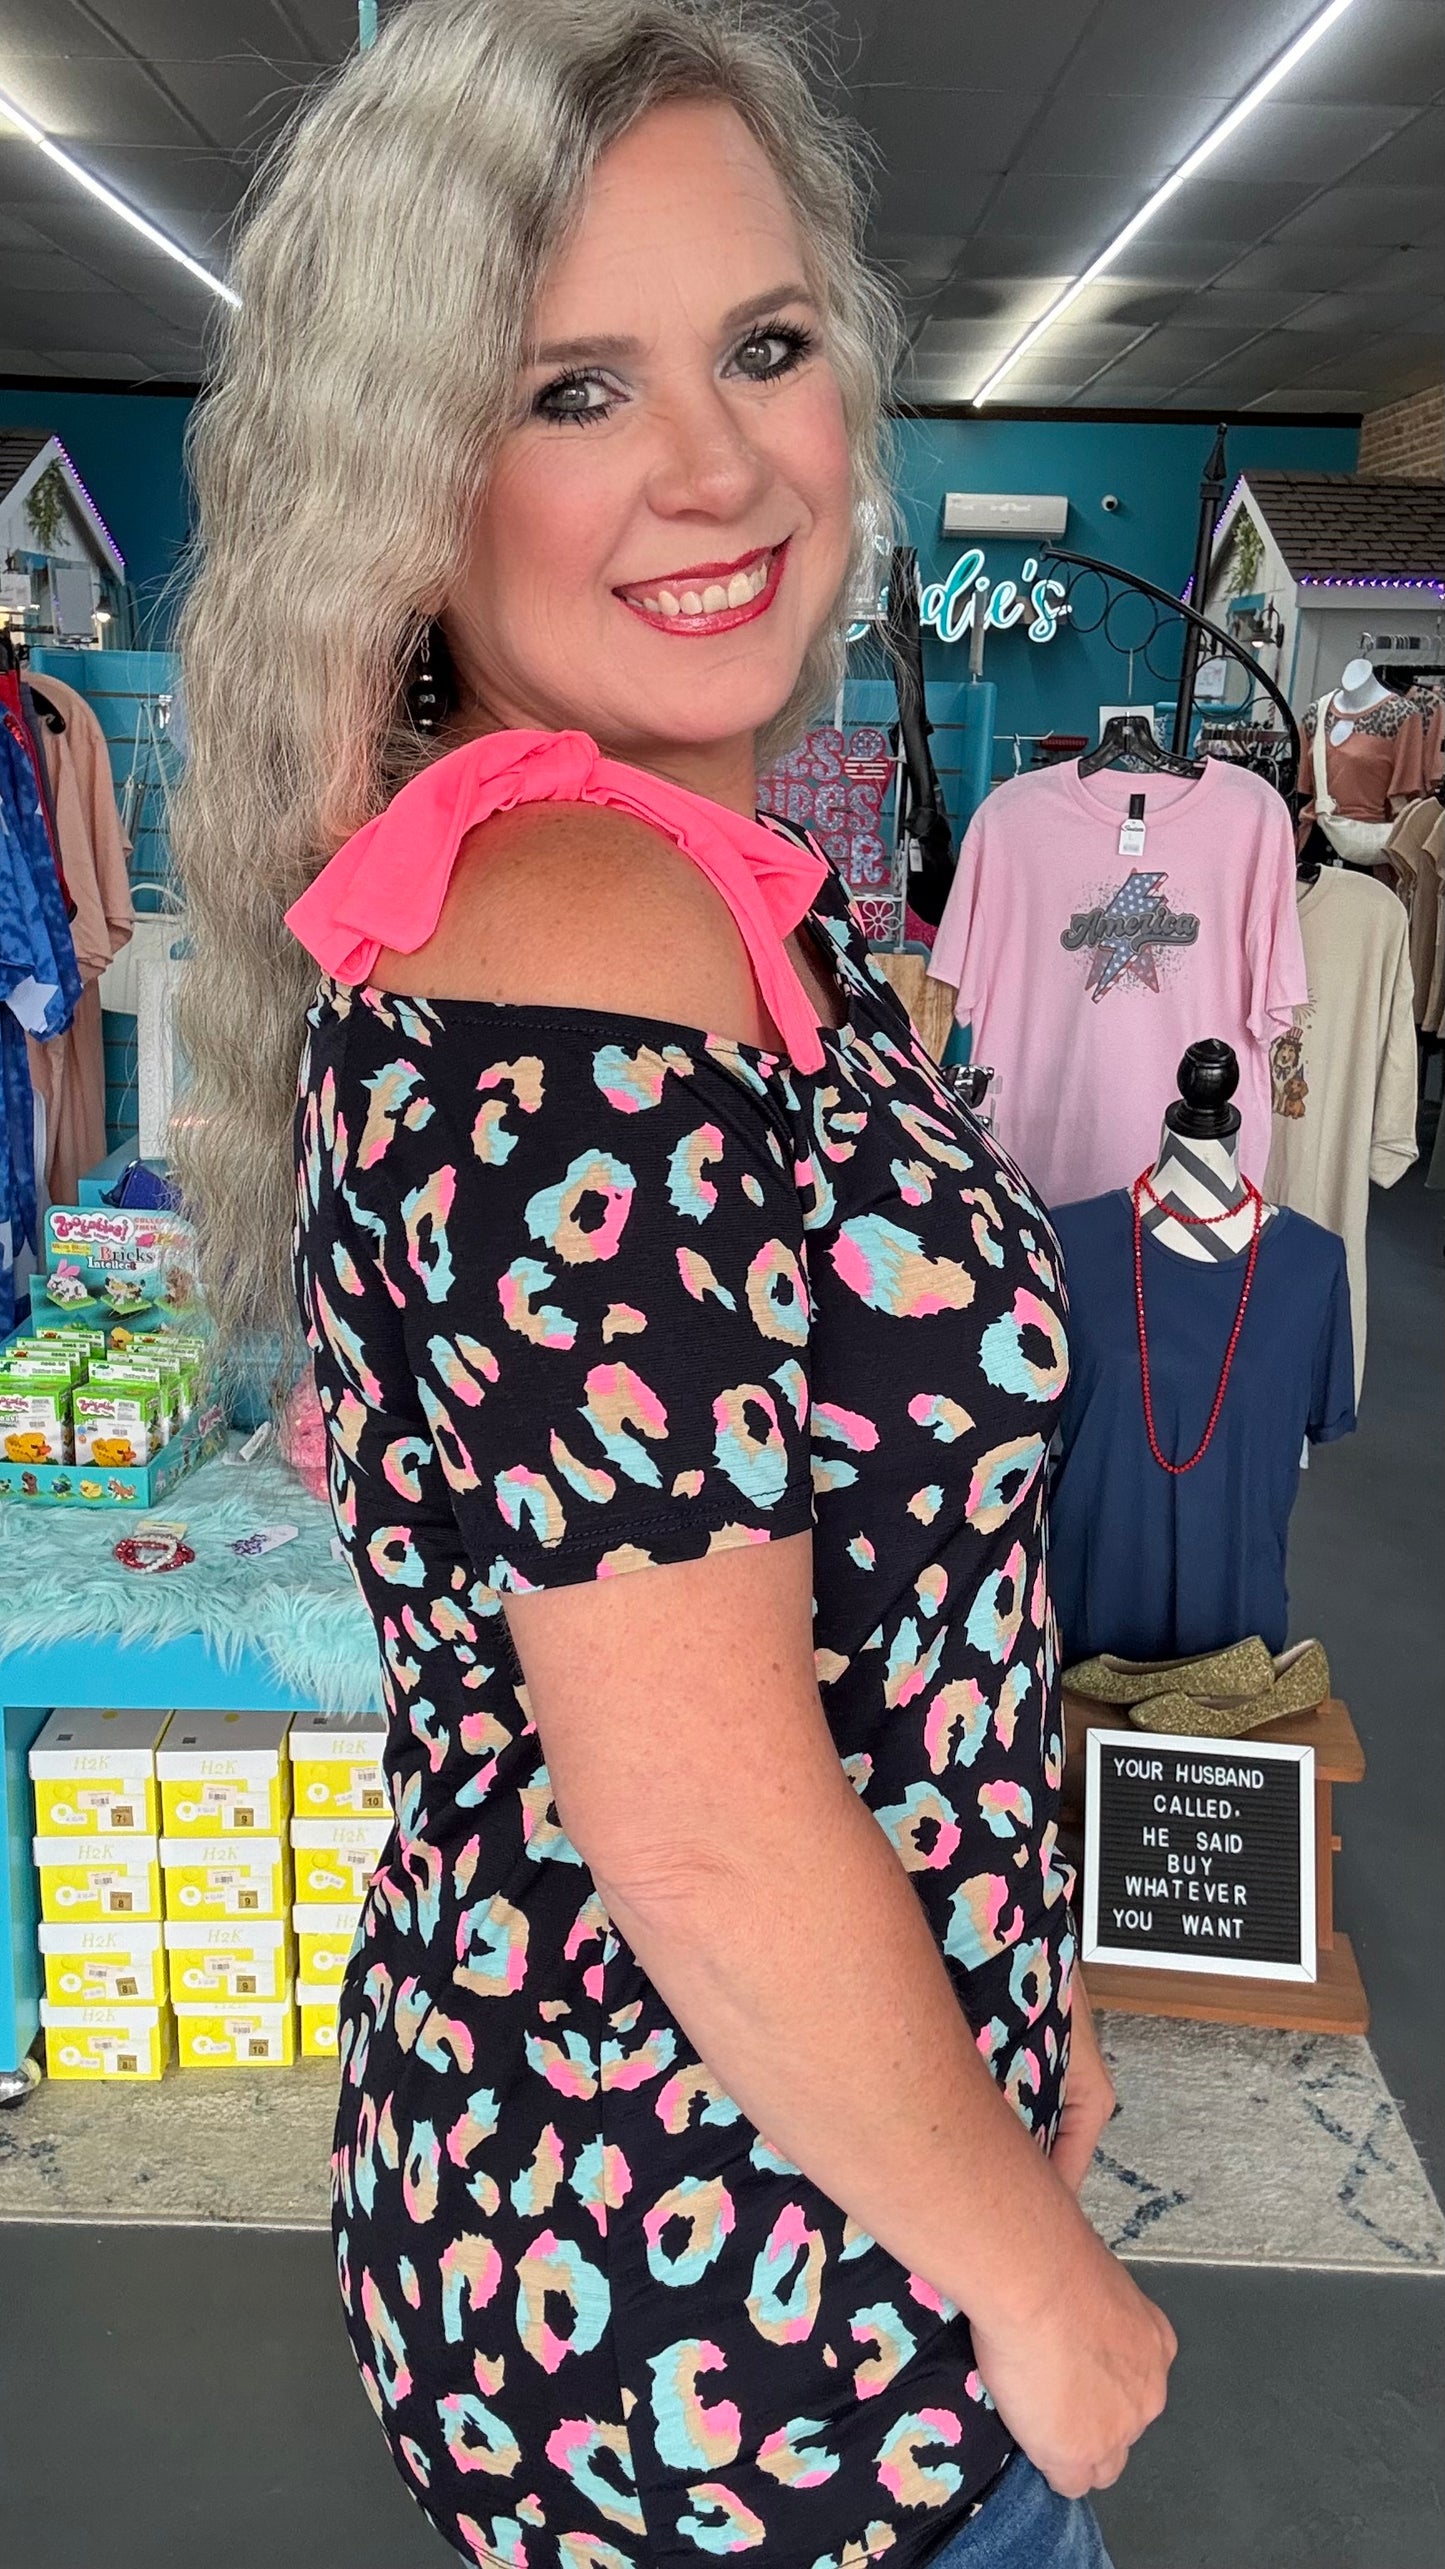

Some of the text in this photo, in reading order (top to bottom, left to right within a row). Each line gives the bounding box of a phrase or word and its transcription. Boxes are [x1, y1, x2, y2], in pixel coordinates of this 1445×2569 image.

[1061, 905, 1200, 955] America
[87, 1256, 137, 1270] Intellect
[100, 1247, 155, 1263] Bricks
[332, 1739, 367, 1754] H2K
[73, 1755, 111, 1771] H2K
[201, 1759, 238, 1775] H2K
[1113, 1757, 1264, 1790] YOUR HUSBAND
[367, 1797, 379, 1806] 10
[1142, 1826, 1243, 1854] HE SAID
[79, 1844, 114, 1860] H2K
[202, 1846, 239, 1861] H2K
[1167, 1853, 1213, 1876] BUY
[1125, 1875, 1247, 1905] WHATEVER
[1112, 1908, 1244, 1939] YOU WANT
[82, 1932, 118, 1948] H2K
[208, 1929, 243, 1943] H2K
[253, 2046, 264, 2054] 10
